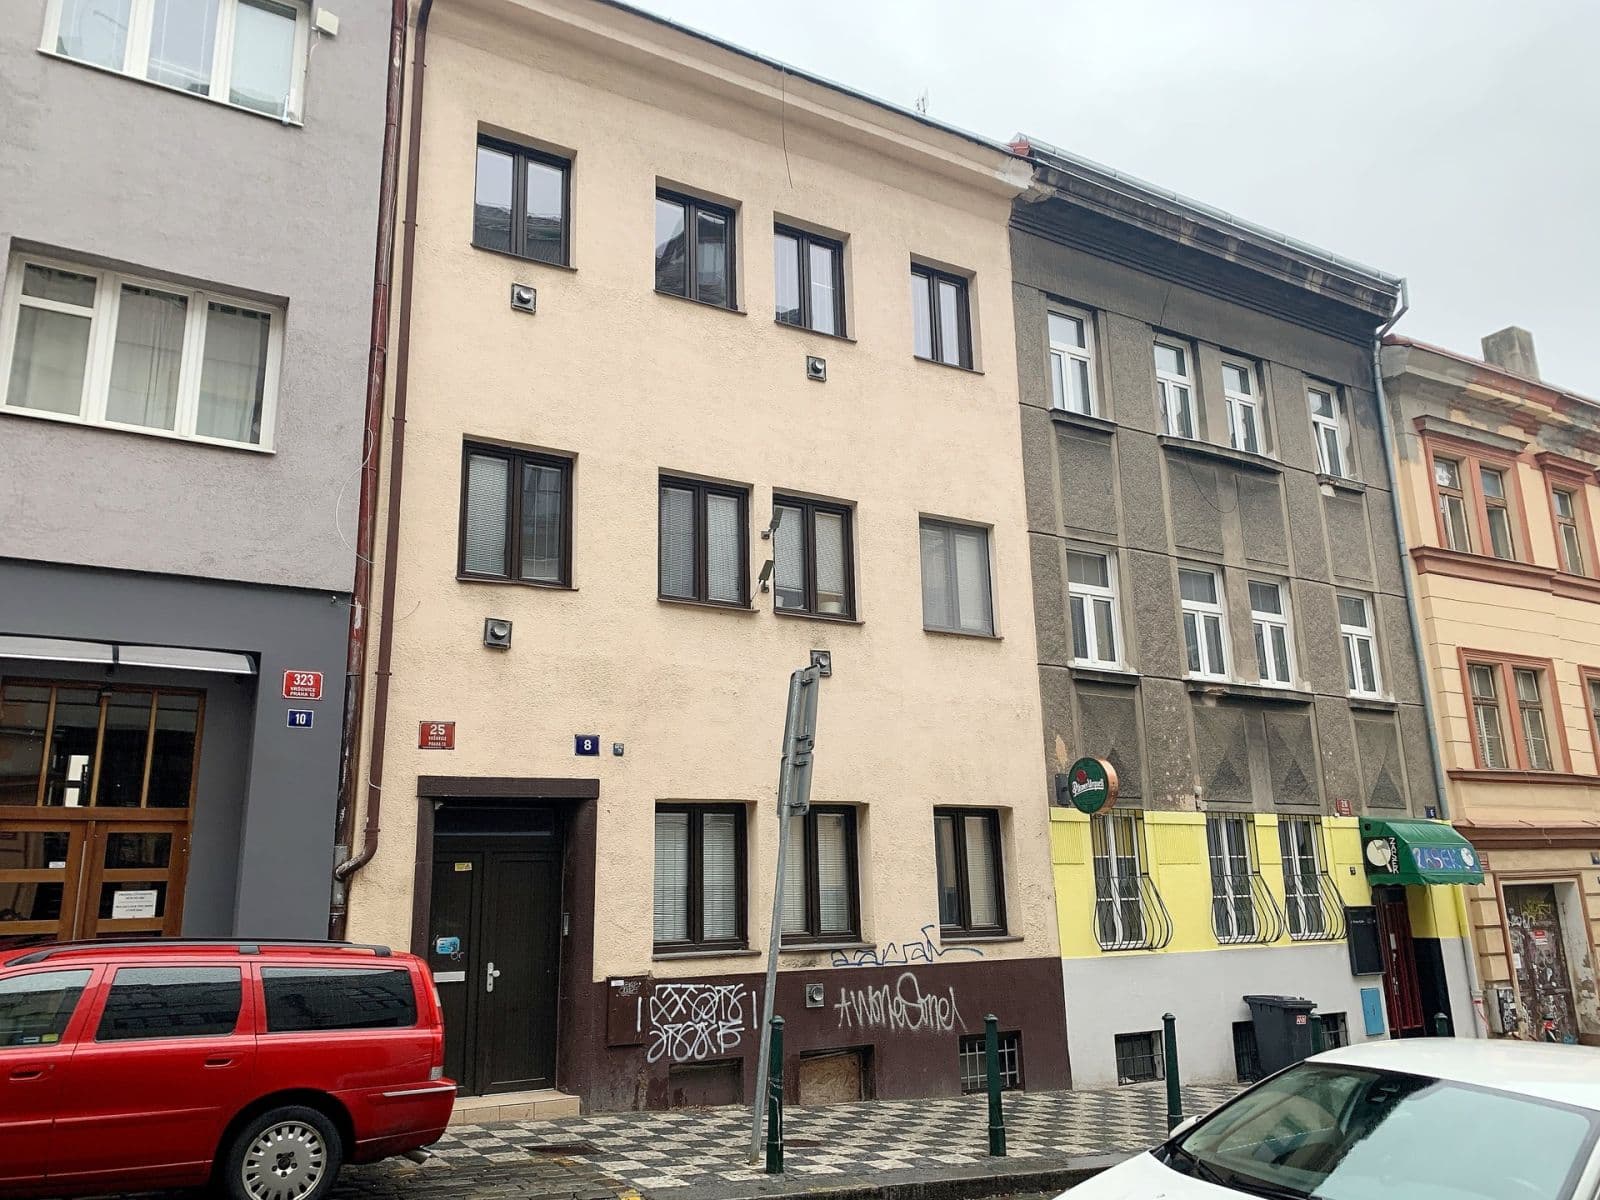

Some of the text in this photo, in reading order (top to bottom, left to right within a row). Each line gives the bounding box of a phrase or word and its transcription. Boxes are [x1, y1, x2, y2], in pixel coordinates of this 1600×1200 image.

[293, 674, 314, 686] 323
[295, 713, 306, 725] 10
[430, 724, 446, 735] 25
[583, 739, 592, 751] 8
